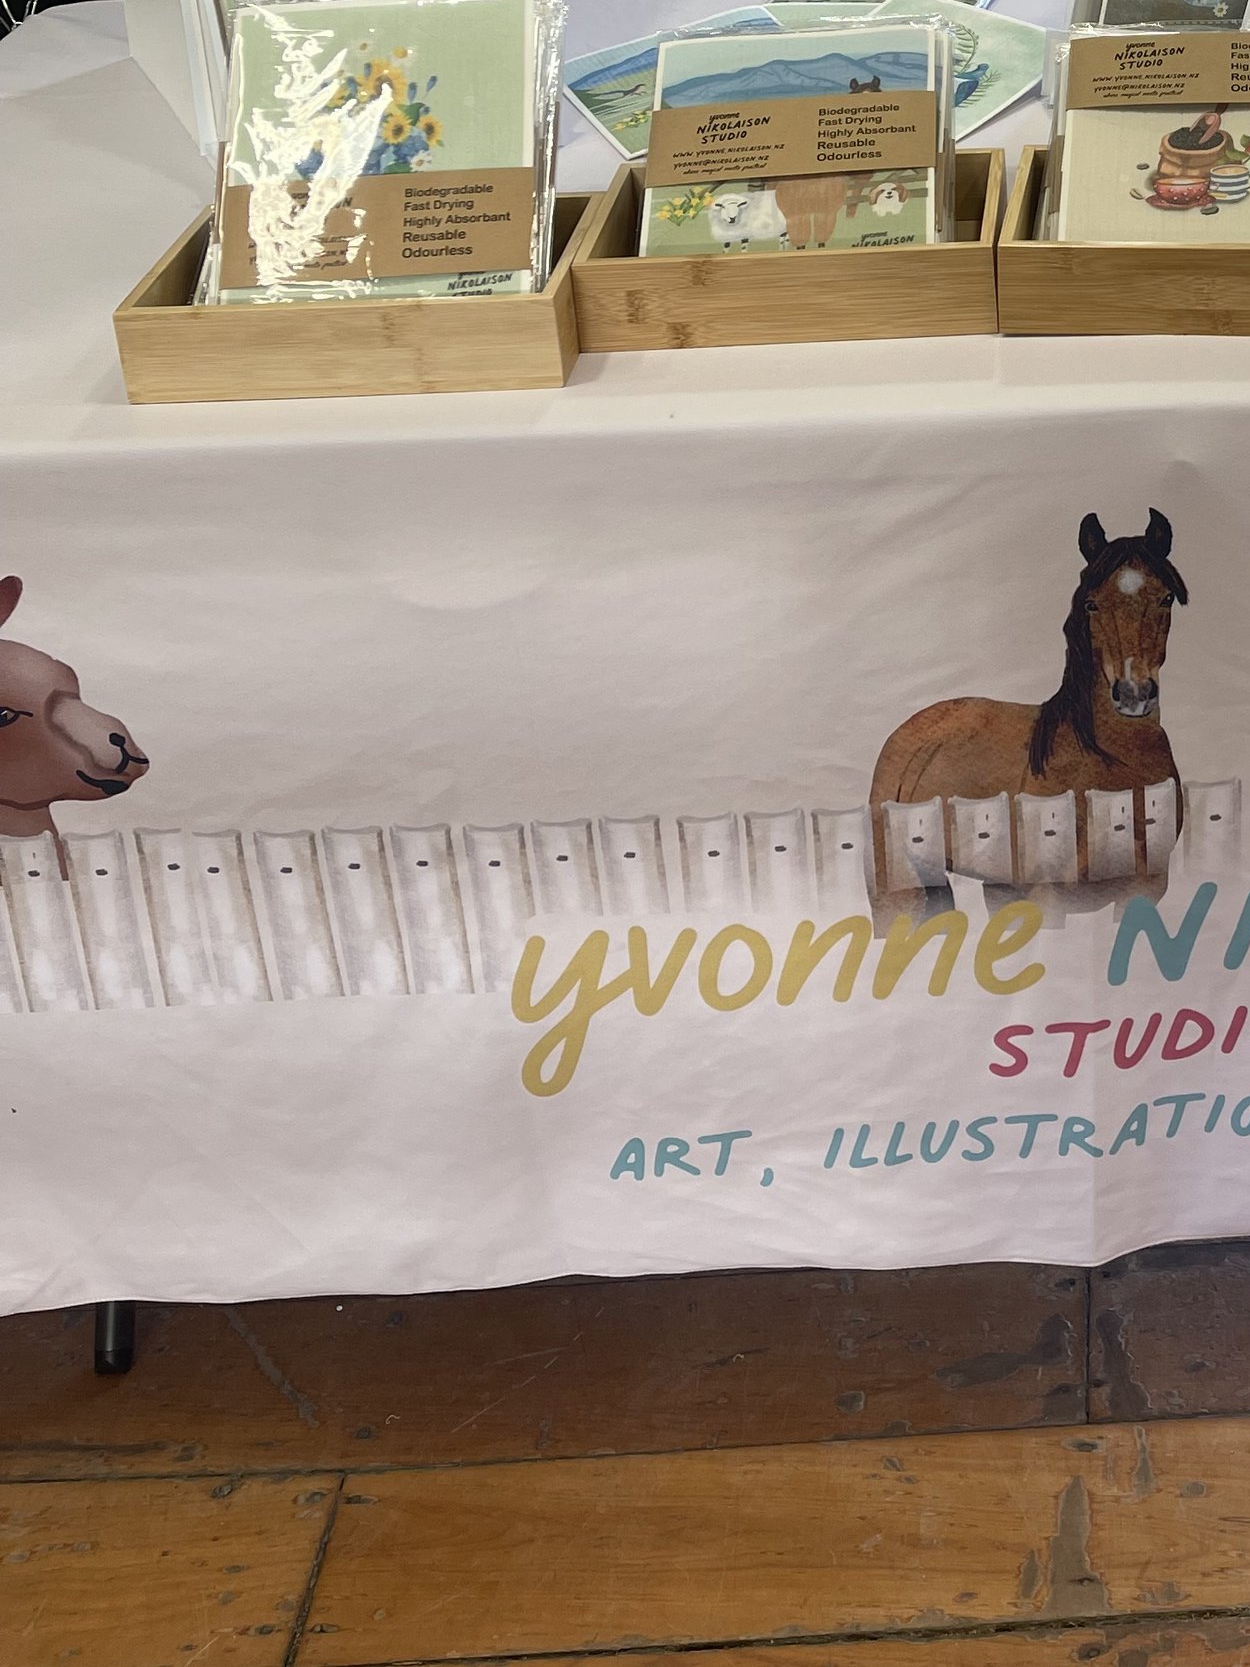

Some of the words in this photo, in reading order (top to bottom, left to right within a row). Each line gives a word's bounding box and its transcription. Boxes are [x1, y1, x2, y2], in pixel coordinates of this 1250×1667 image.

[1126, 42, 1155, 52] yvonne
[1114, 47, 1185, 61] NIKOLAISON
[1119, 59, 1163, 70] STUDIO
[818, 104, 900, 117] Biodegradable
[697, 116, 771, 134] NIKOLAISON
[818, 118, 842, 126] Fast
[845, 116, 882, 125] Drying
[701, 131, 747, 144] STUDIO
[818, 129, 853, 139] Highly
[856, 125, 916, 135] Absorbant
[817, 138, 876, 150] Reusable
[817, 151, 882, 162] Odourless
[404, 184, 494, 198] Biodegradable
[404, 201, 430, 211] Fast
[433, 199, 474, 211] Drying
[403, 216, 442, 228] Highly
[445, 212, 511, 224] Absorbant
[403, 230, 466, 243] Reusable
[401, 246, 473, 259] Odourless
[447, 273, 512, 290] NIKOLAISON
[511, 899, 1046, 1098] yvonne
[609, 1129, 776, 1187] ART,
